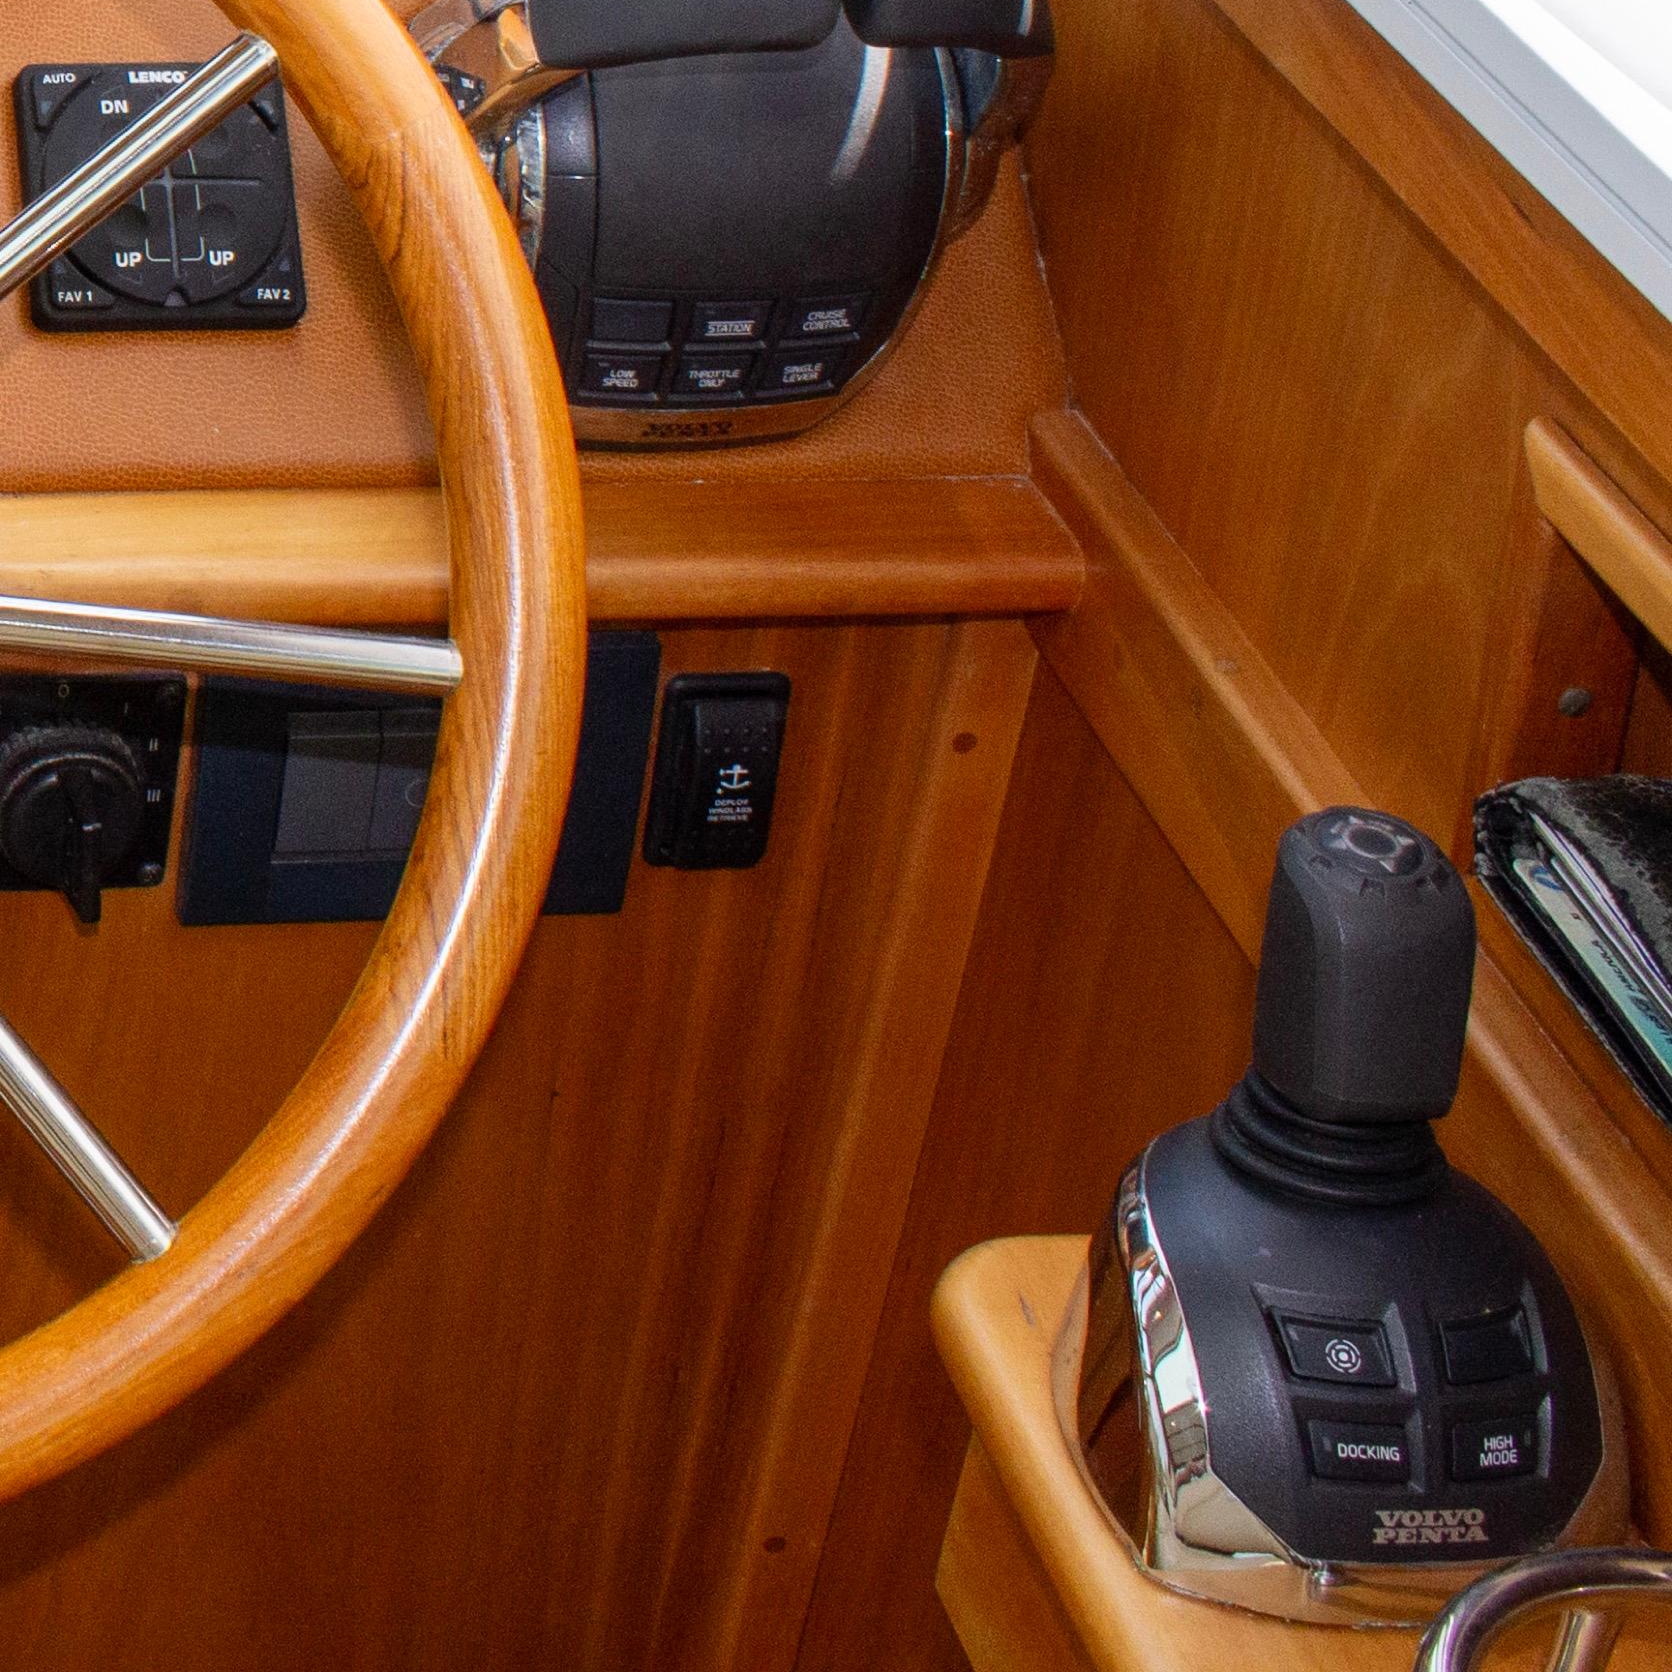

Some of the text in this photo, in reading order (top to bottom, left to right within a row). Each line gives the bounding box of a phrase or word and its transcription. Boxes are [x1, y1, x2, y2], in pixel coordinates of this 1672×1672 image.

[42, 71, 185, 85] AUTO LENCO
[100, 99, 130, 115] DN
[114, 250, 235, 268] UP UP
[57, 290, 93, 303] FAV 1
[256, 289, 291, 301] FAV 2
[806, 309, 847, 321] CRUISE
[706, 323, 752, 334] STATION
[802, 319, 851, 332] CONTROL
[609, 370, 637, 379] LOW
[688, 369, 742, 380] THROTTLE
[782, 363, 823, 374] SINGLE
[601, 378, 639, 389] SPEED
[697, 379, 725, 388] ONLY
[781, 372, 819, 383] LEVER
[1483, 1434, 1514, 1452] HIGH
[1337, 1442, 1401, 1461] DOCKING
[1479, 1449, 1518, 1467] MODE
[1375, 1508, 1485, 1527] VOLVO
[1372, 1526, 1490, 1545] PENTA
